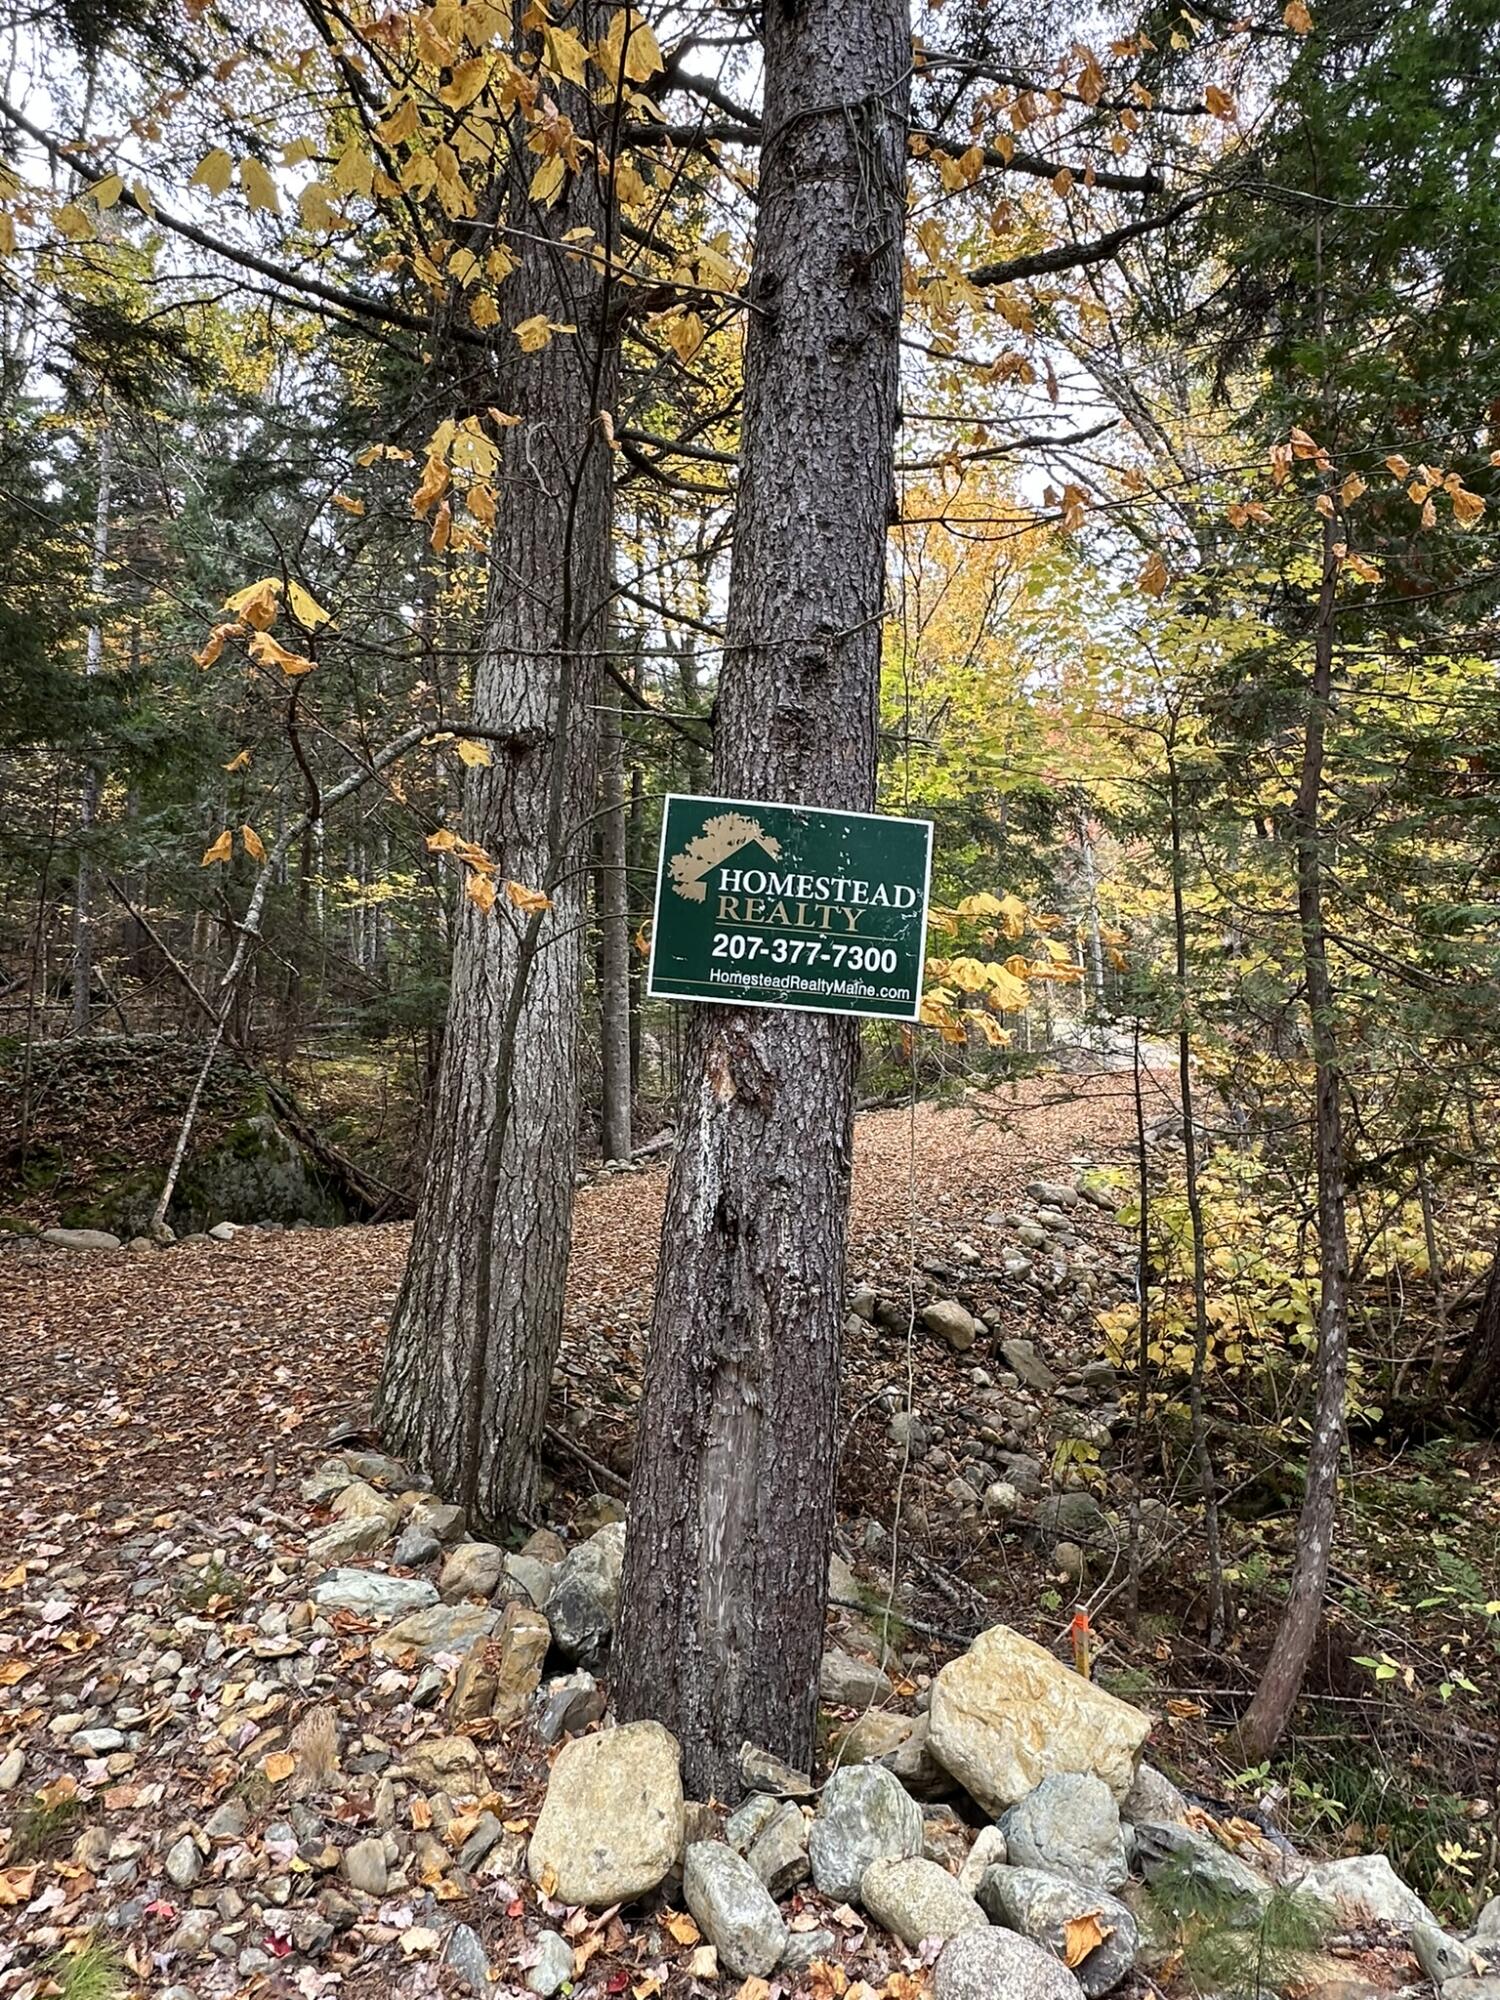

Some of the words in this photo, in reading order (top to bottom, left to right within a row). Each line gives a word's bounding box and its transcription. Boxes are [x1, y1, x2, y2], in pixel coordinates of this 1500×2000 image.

[718, 868, 916, 908] HOMESTEAD
[716, 895, 867, 931] REALTY
[712, 933, 897, 973] 207-377-7300
[709, 968, 910, 1000] HomesteadRealtyMaine.com
